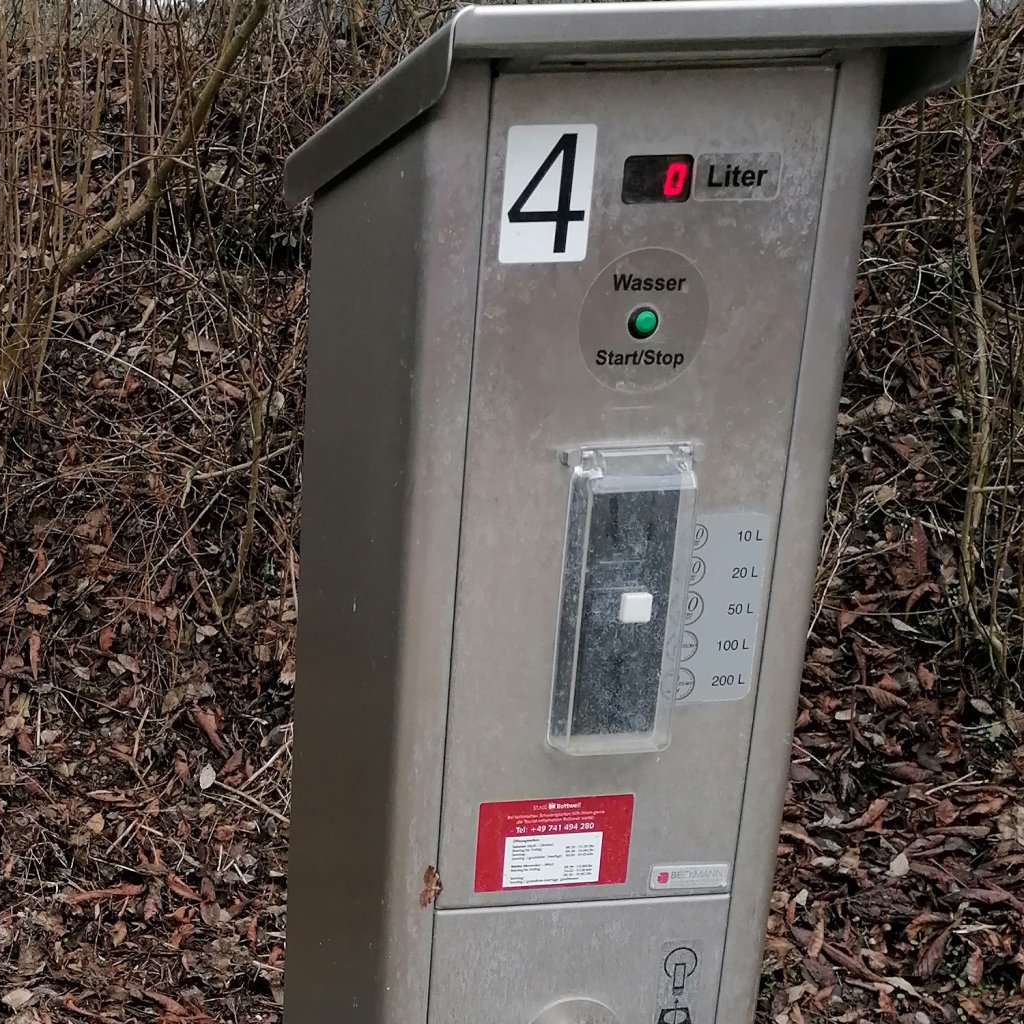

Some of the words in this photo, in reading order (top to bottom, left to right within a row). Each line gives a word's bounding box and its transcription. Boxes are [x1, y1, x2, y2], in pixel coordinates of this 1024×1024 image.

[663, 162, 687, 197] 0
[707, 164, 768, 188] Liter
[507, 132, 586, 254] 4
[613, 274, 686, 292] Wasser
[595, 350, 685, 368] Start/Stop
[738, 531, 752, 542] 10
[755, 530, 763, 541] L
[732, 567, 748, 579] 20
[751, 567, 758, 578] L
[727, 603, 743, 615] 50
[746, 603, 753, 614] L
[717, 639, 739, 651] 100
[742, 639, 750, 650] L
[711, 675, 735, 687] 200
[738, 674, 745, 685] L
[516, 826, 528, 834] Tel:
[548, 824, 562, 832] 741
[564, 823, 578, 831] 494
[580, 822, 595, 830] 280
